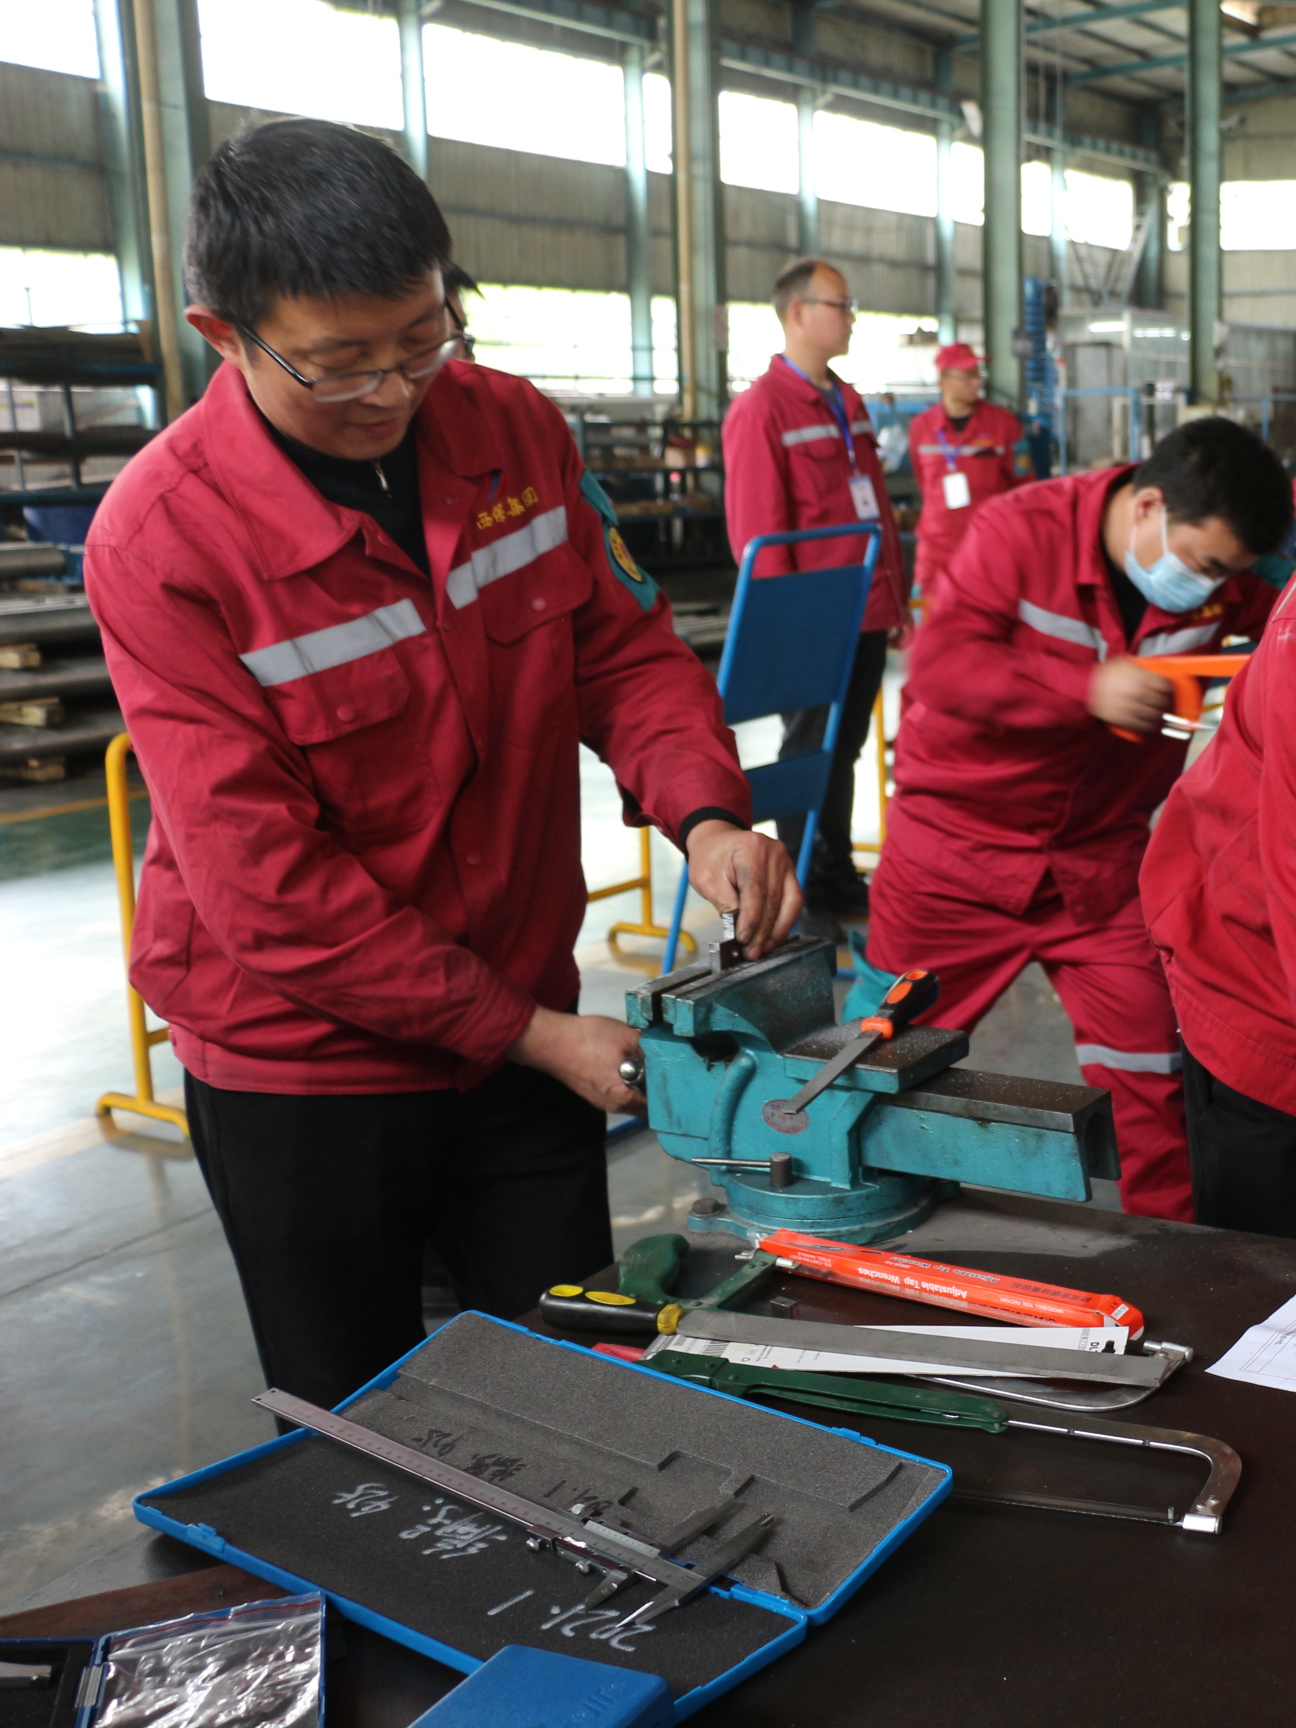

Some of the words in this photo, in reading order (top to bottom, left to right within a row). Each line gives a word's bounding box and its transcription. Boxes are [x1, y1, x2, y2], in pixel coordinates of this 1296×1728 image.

[889, 1256, 932, 1268] Wrenches
[932, 1263, 950, 1273] Tap
[857, 1267, 901, 1285] Wrenches
[903, 1276, 920, 1290] Tap
[953, 1269, 1001, 1283] Adjustable
[920, 1280, 968, 1299] Adjustable
[1000, 1297, 1021, 1306] FACTORY
